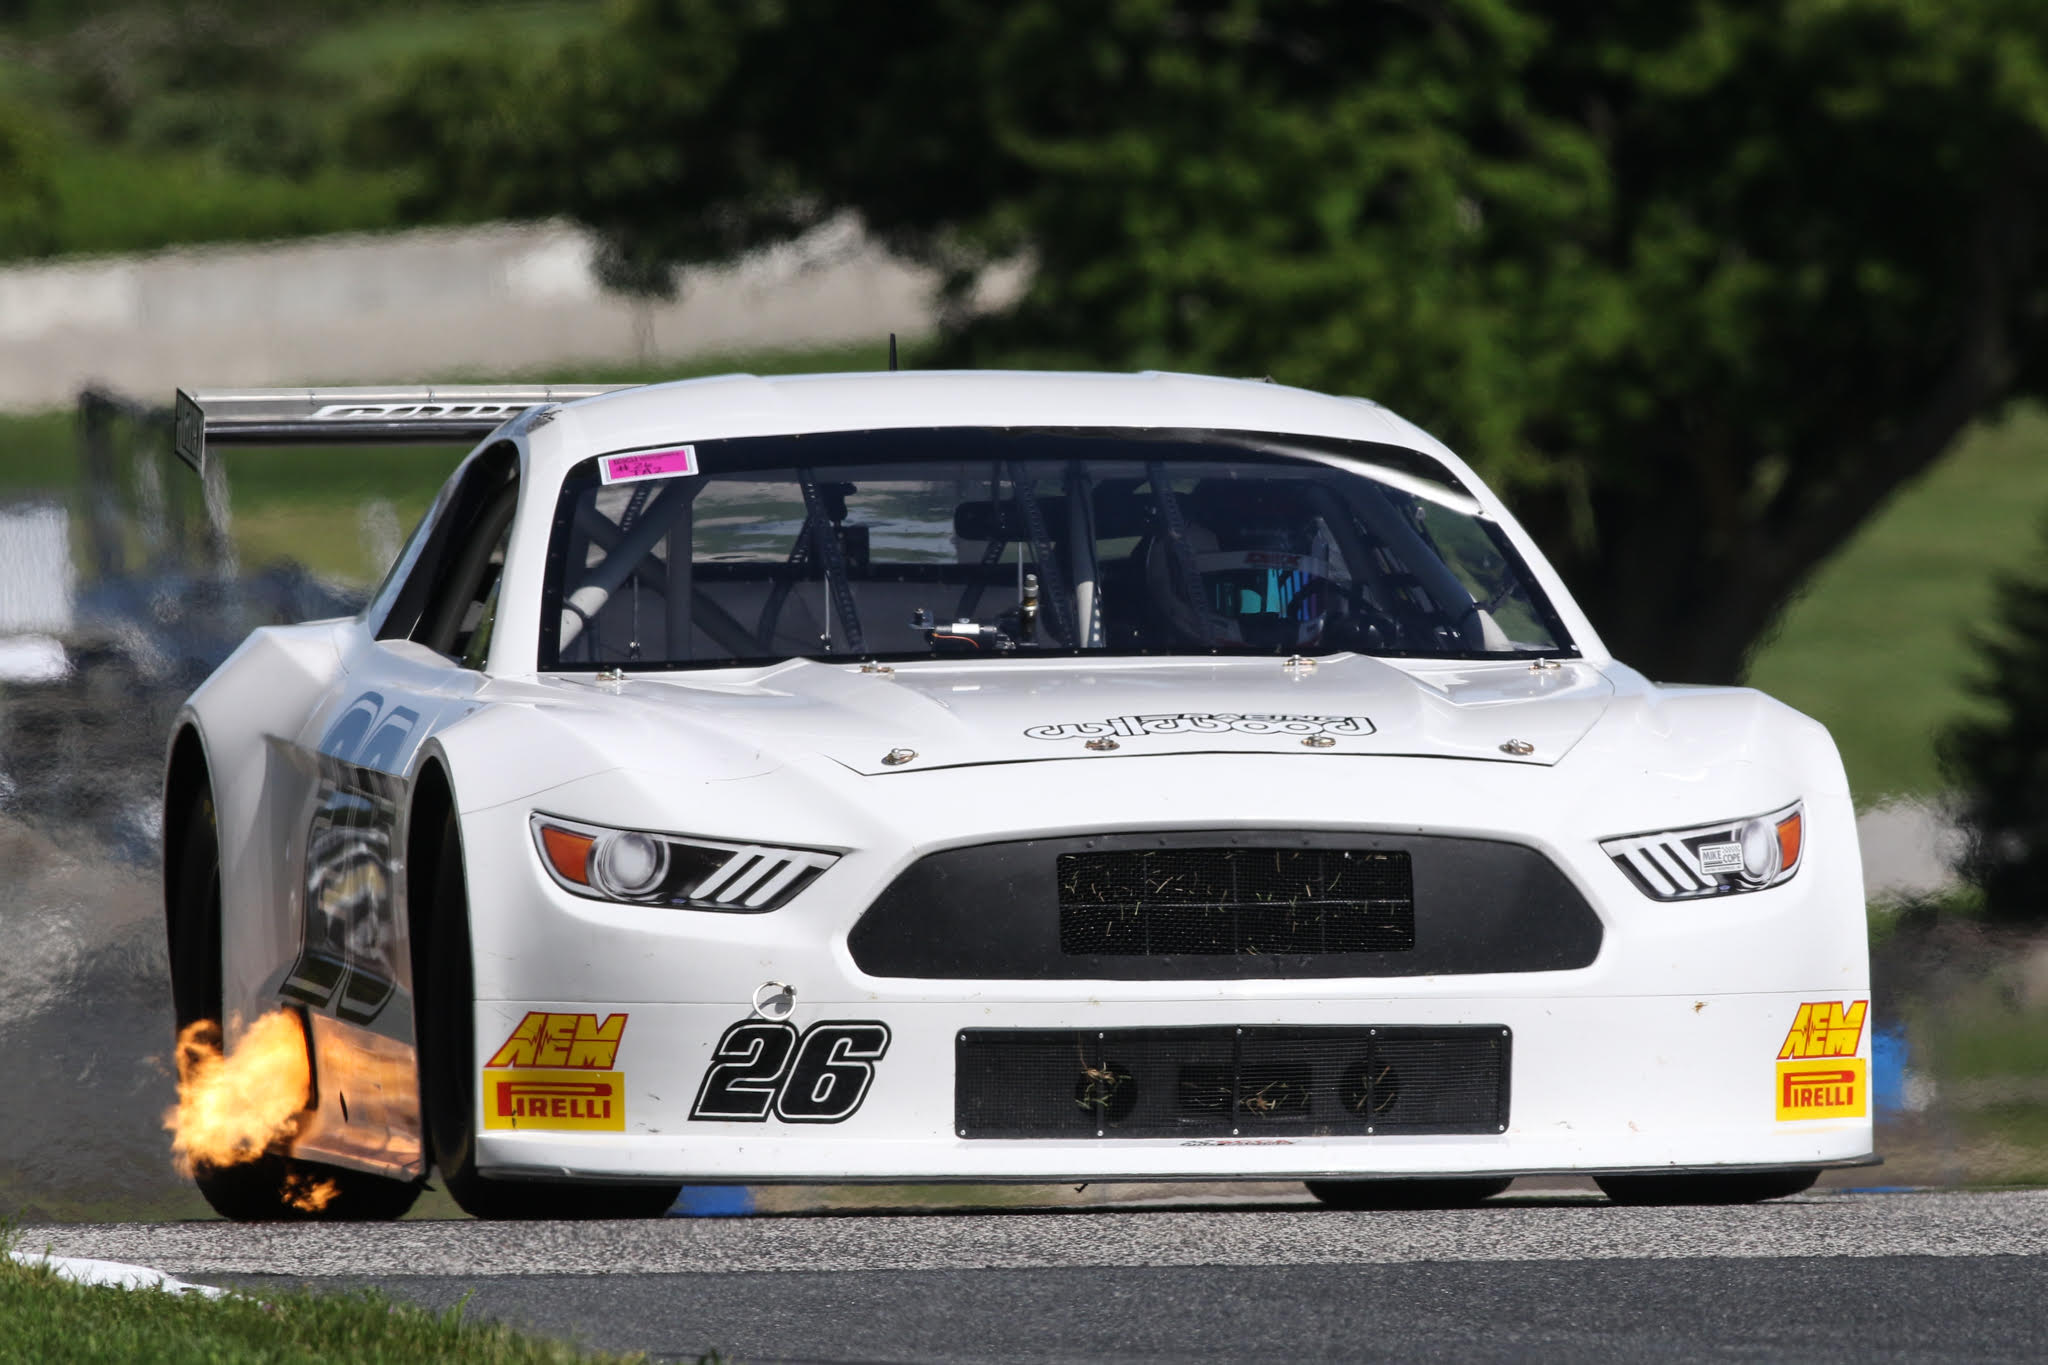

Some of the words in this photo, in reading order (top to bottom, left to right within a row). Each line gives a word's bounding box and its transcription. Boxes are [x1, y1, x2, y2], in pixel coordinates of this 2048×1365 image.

[1703, 850, 1722, 860] MIKE
[484, 1011, 629, 1070] AEM
[1776, 1000, 1869, 1060] AEM
[688, 1018, 892, 1124] 26
[1783, 1070, 1856, 1108] PIRELLI
[497, 1082, 613, 1118] PIRELLI
